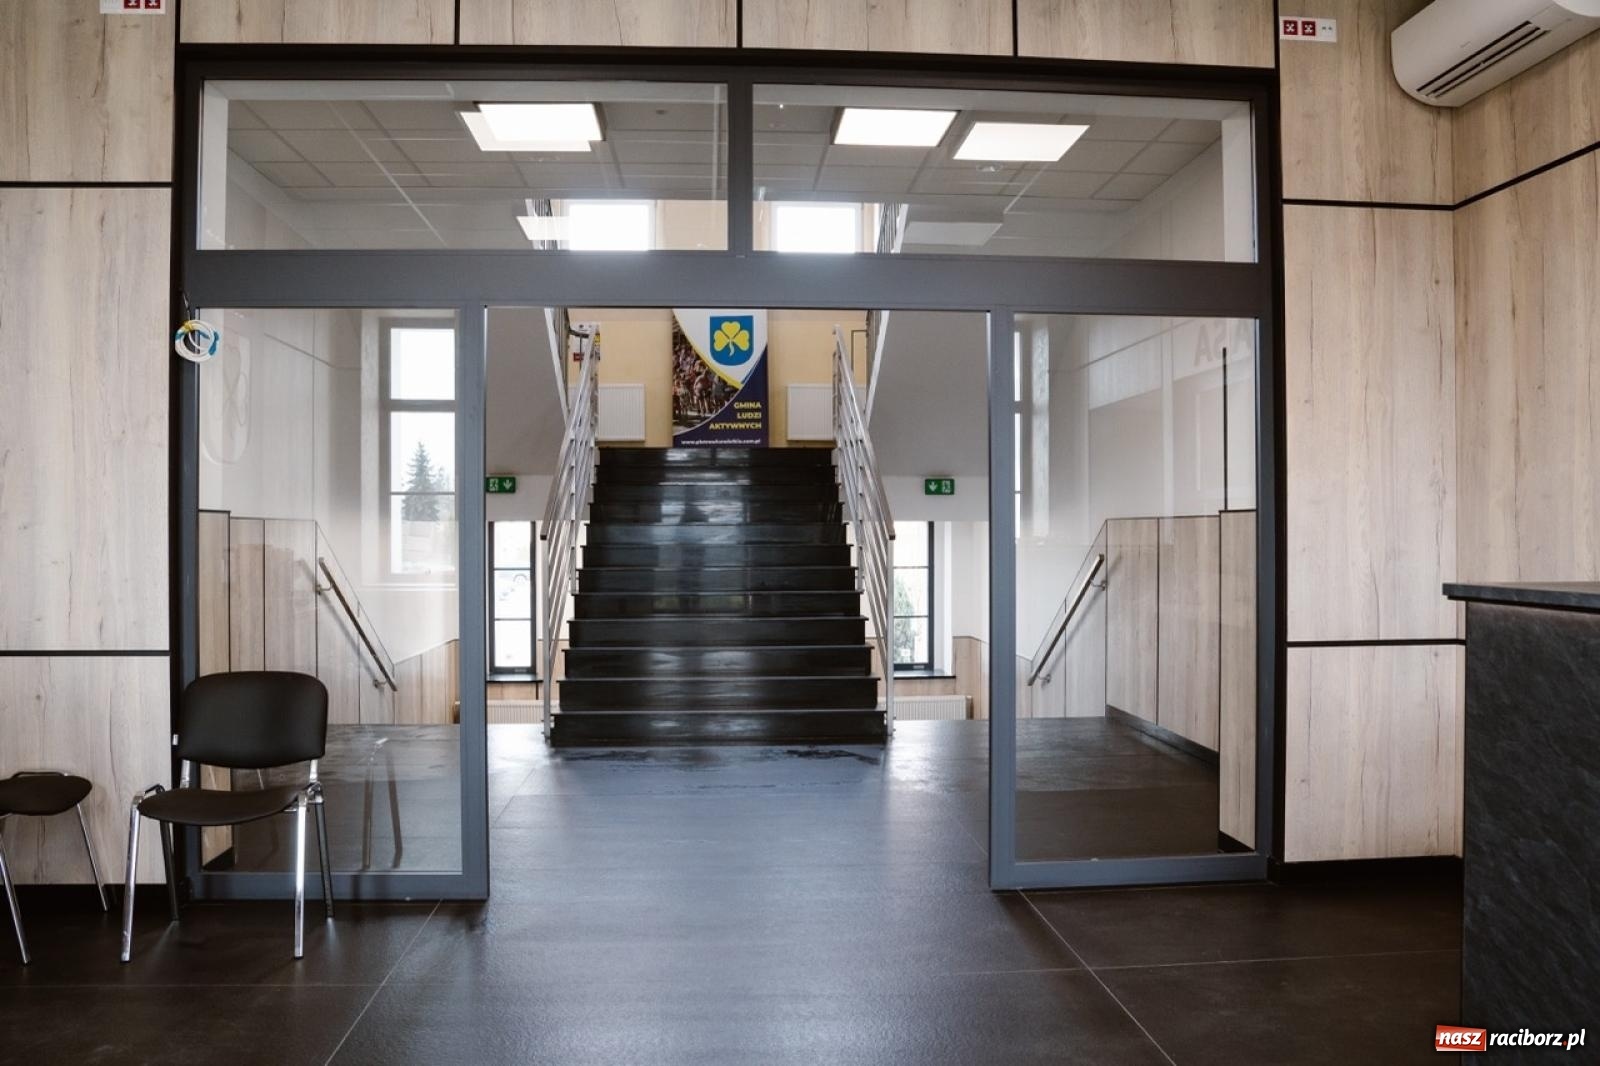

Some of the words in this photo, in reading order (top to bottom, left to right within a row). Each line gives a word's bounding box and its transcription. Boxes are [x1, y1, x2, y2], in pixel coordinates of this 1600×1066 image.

[733, 401, 762, 409] GMINA
[736, 411, 762, 419] LUDZI
[709, 422, 762, 430] AKTYWNYCH
